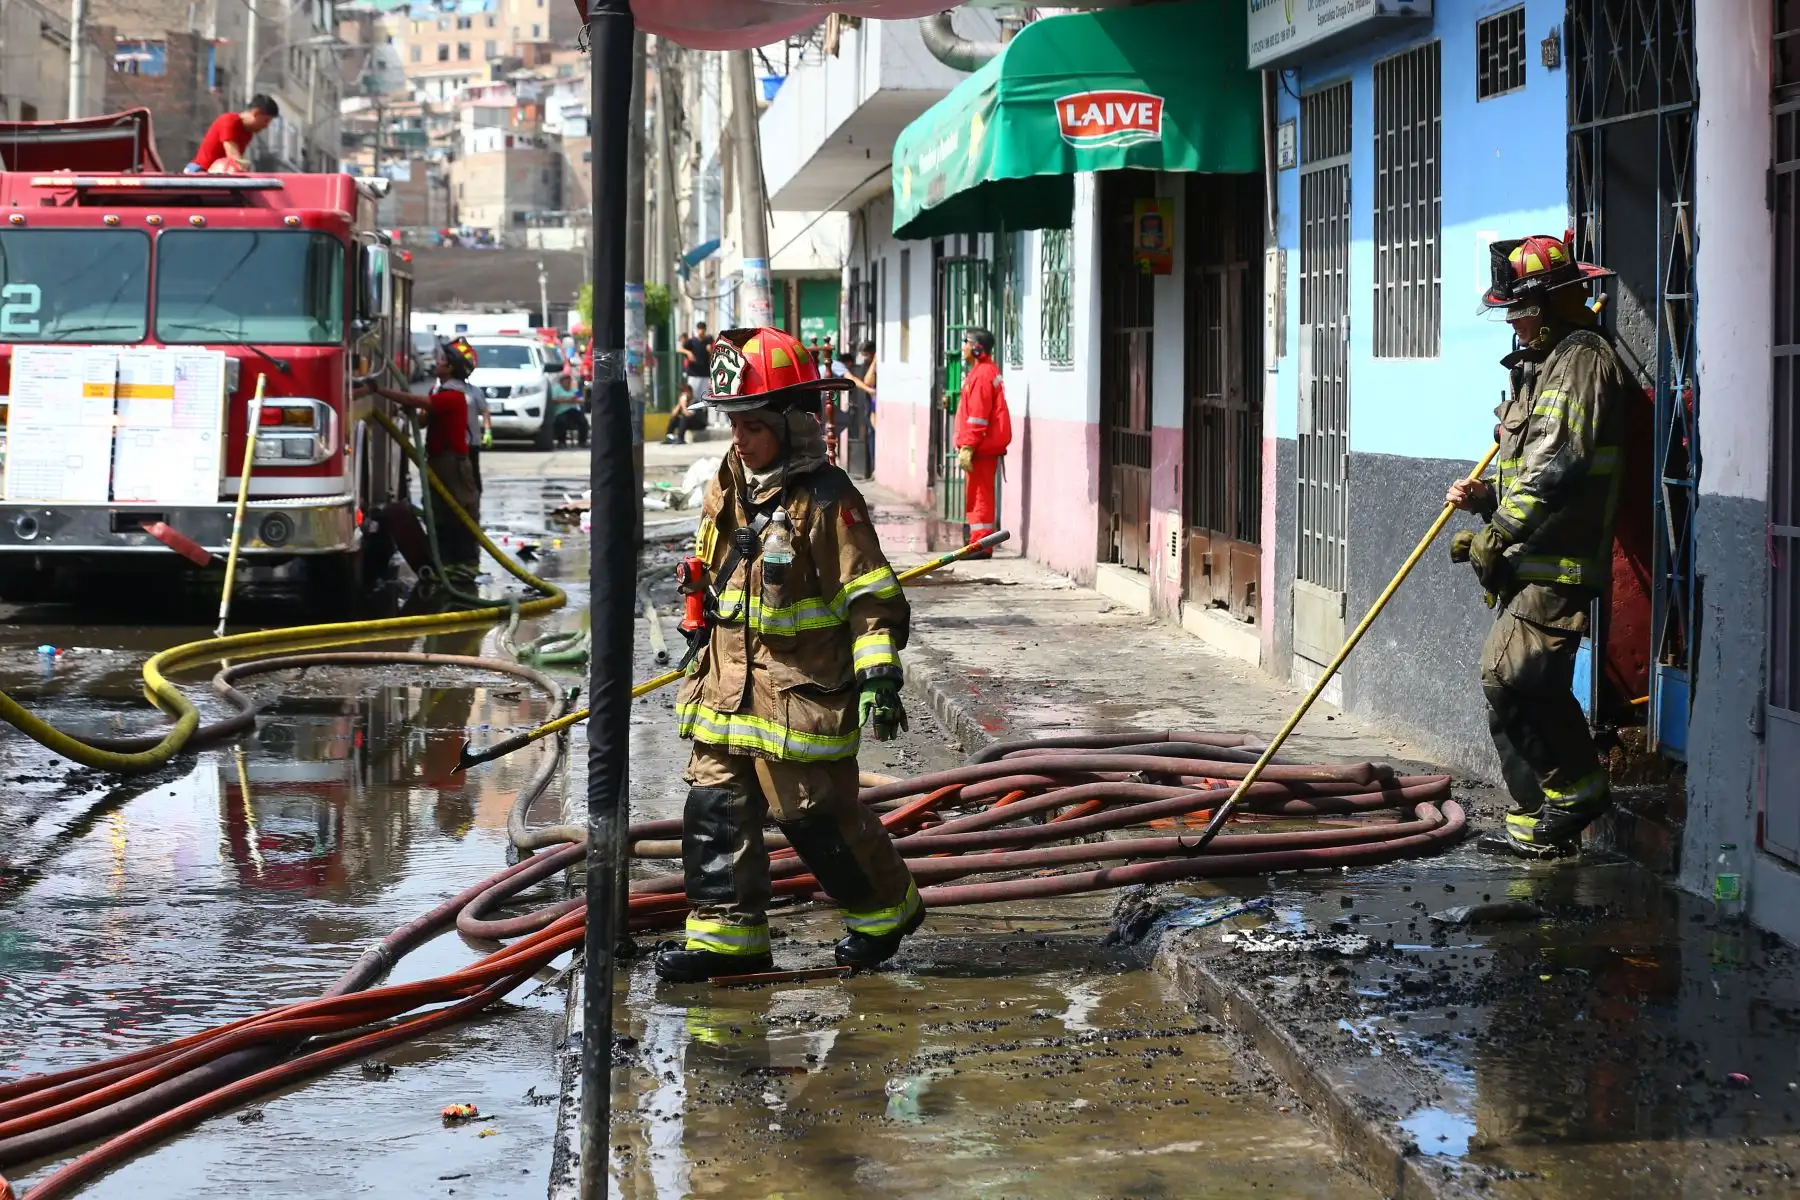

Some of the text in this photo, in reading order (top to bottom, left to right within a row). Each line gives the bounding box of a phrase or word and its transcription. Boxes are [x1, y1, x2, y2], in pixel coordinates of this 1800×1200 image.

[1066, 102, 1154, 127] LAIVE
[1, 283, 41, 333] 2
[718, 369, 726, 386] 2
